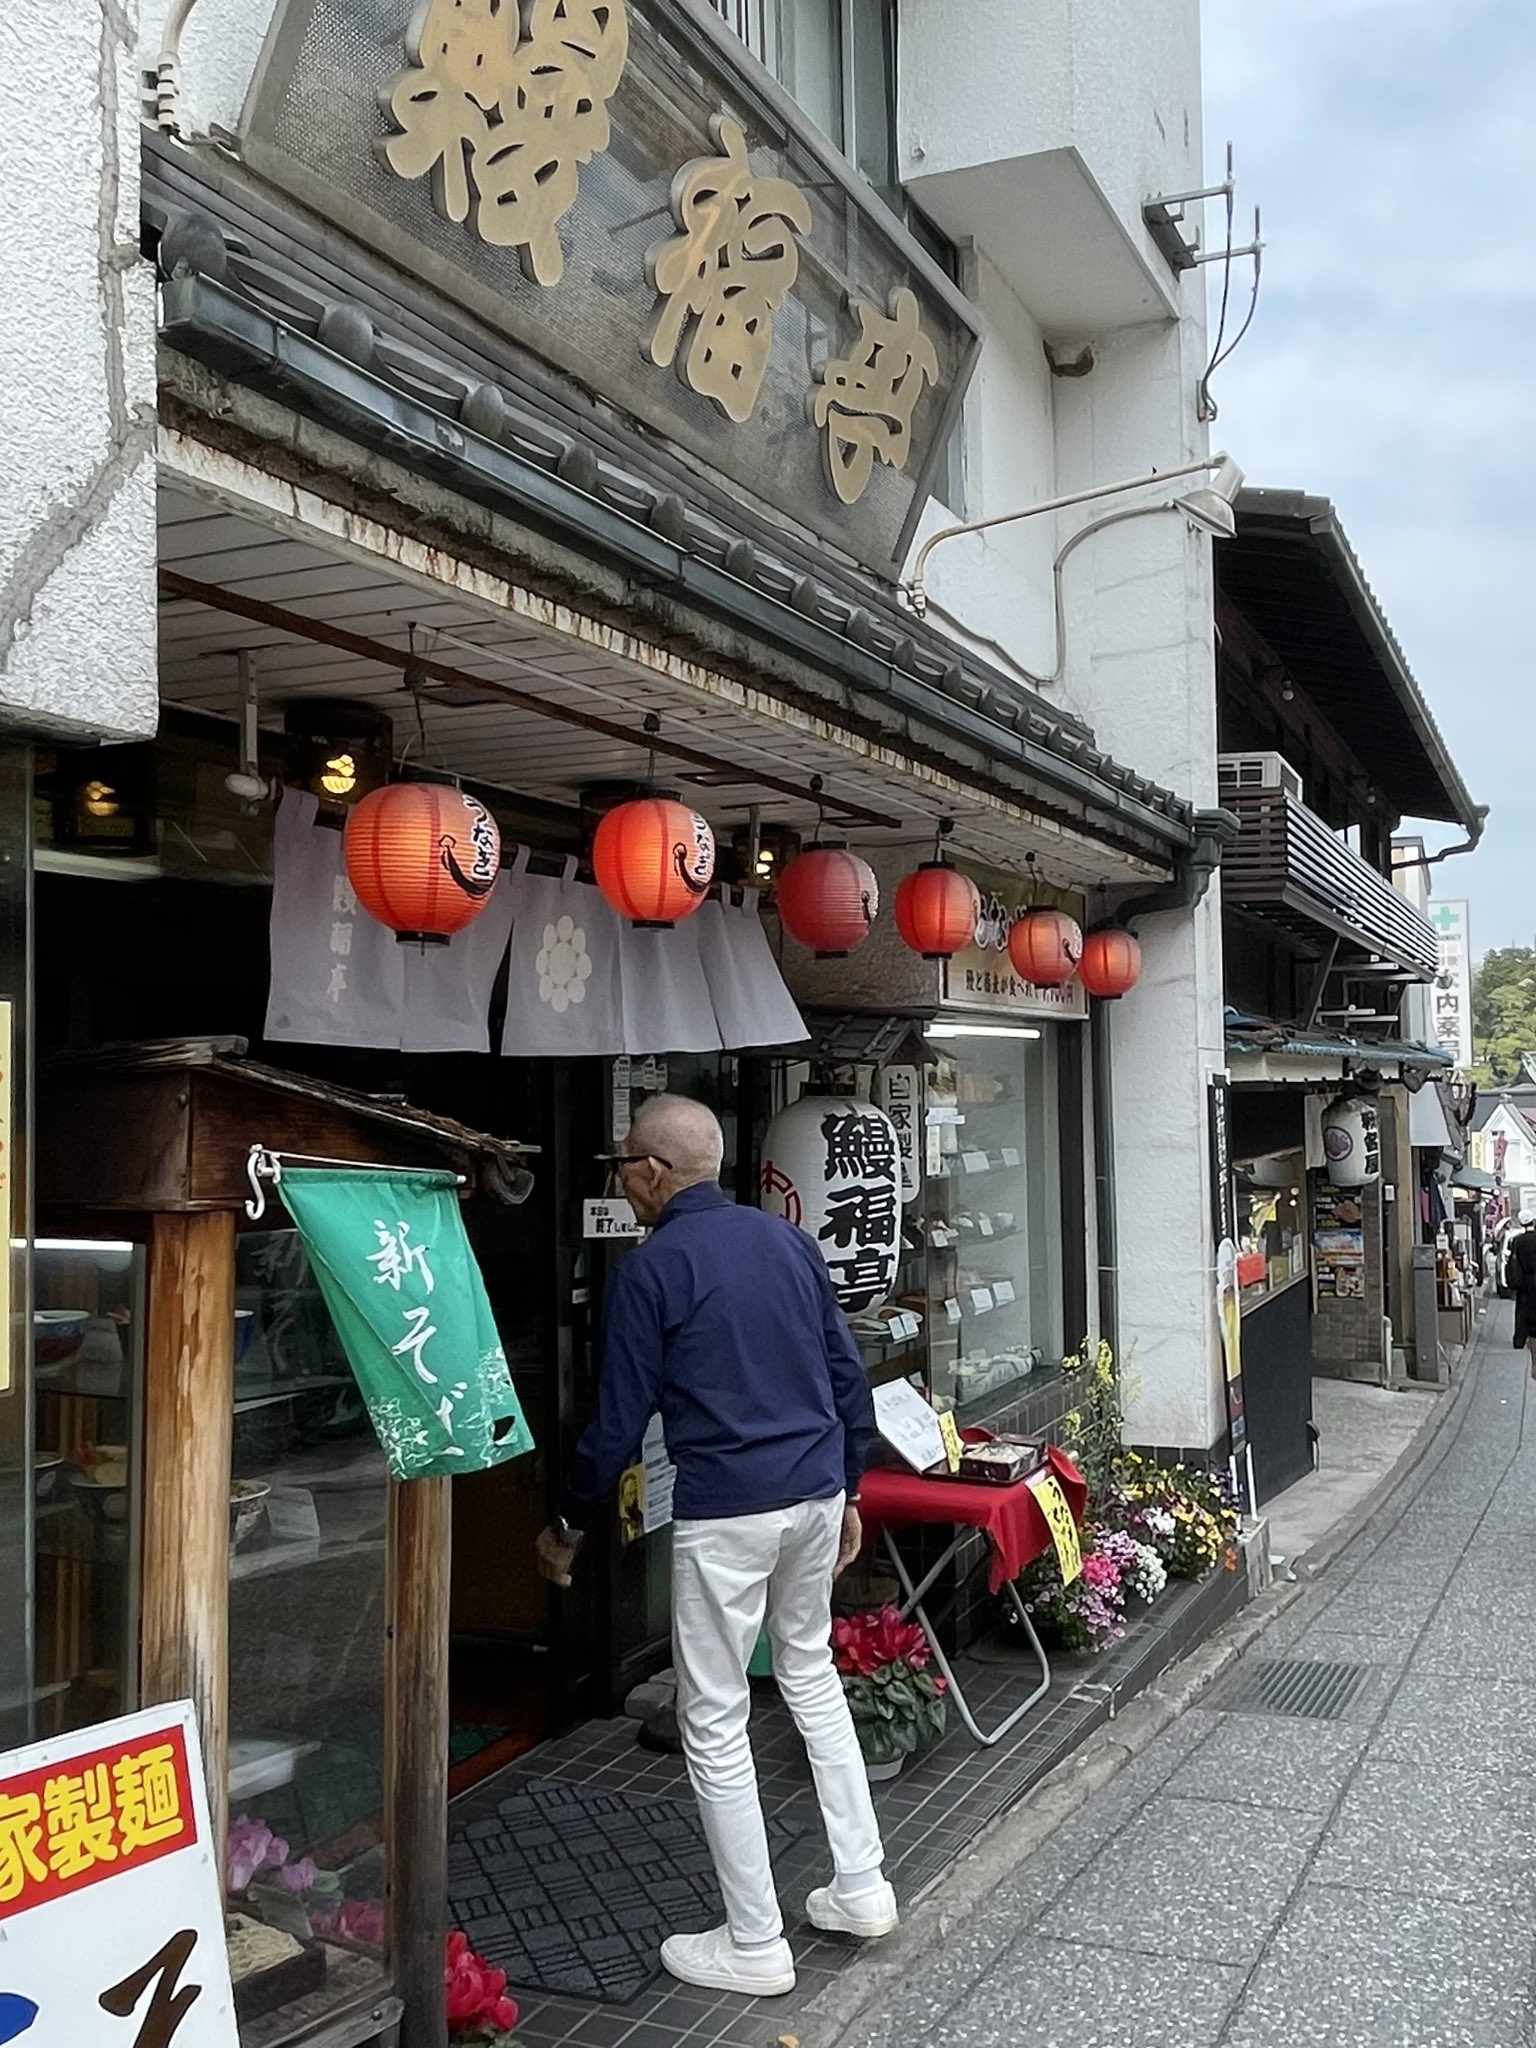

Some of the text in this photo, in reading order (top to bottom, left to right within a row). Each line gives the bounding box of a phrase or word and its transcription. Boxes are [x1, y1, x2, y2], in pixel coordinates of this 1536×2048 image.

[1436, 969, 1460, 1061] 内薬局
[818, 1112, 896, 1314] 鰻福亭
